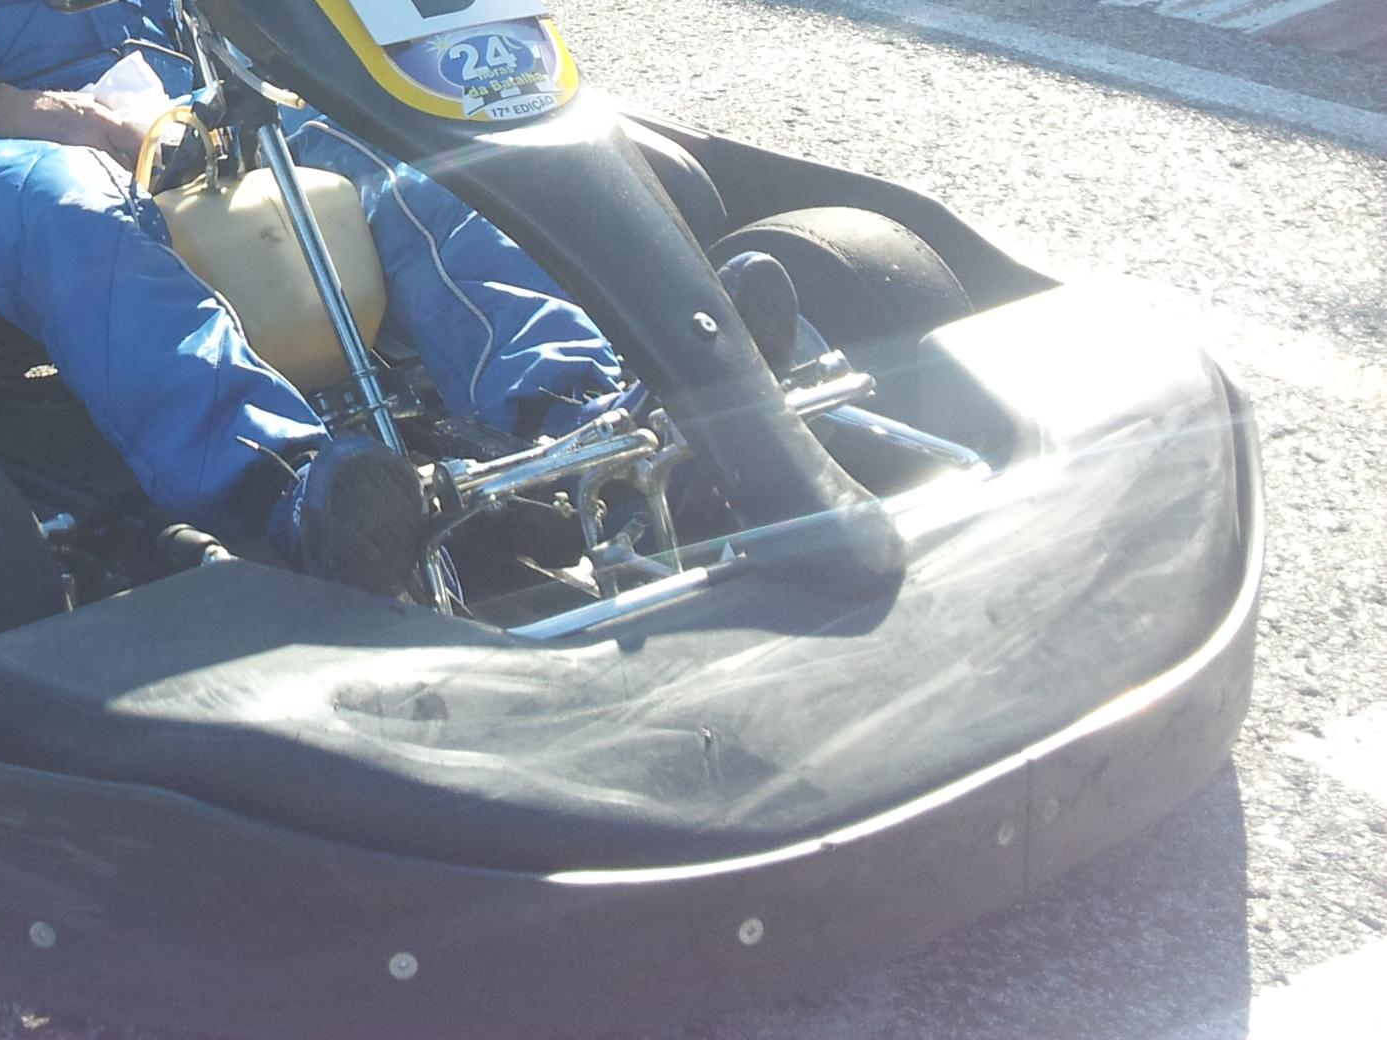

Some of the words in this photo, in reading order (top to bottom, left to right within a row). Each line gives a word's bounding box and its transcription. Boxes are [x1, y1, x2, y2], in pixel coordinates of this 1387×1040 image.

[449, 35, 517, 81] 24
[468, 83, 488, 99] da
[514, 95, 555, 114] EDIÇÃO
